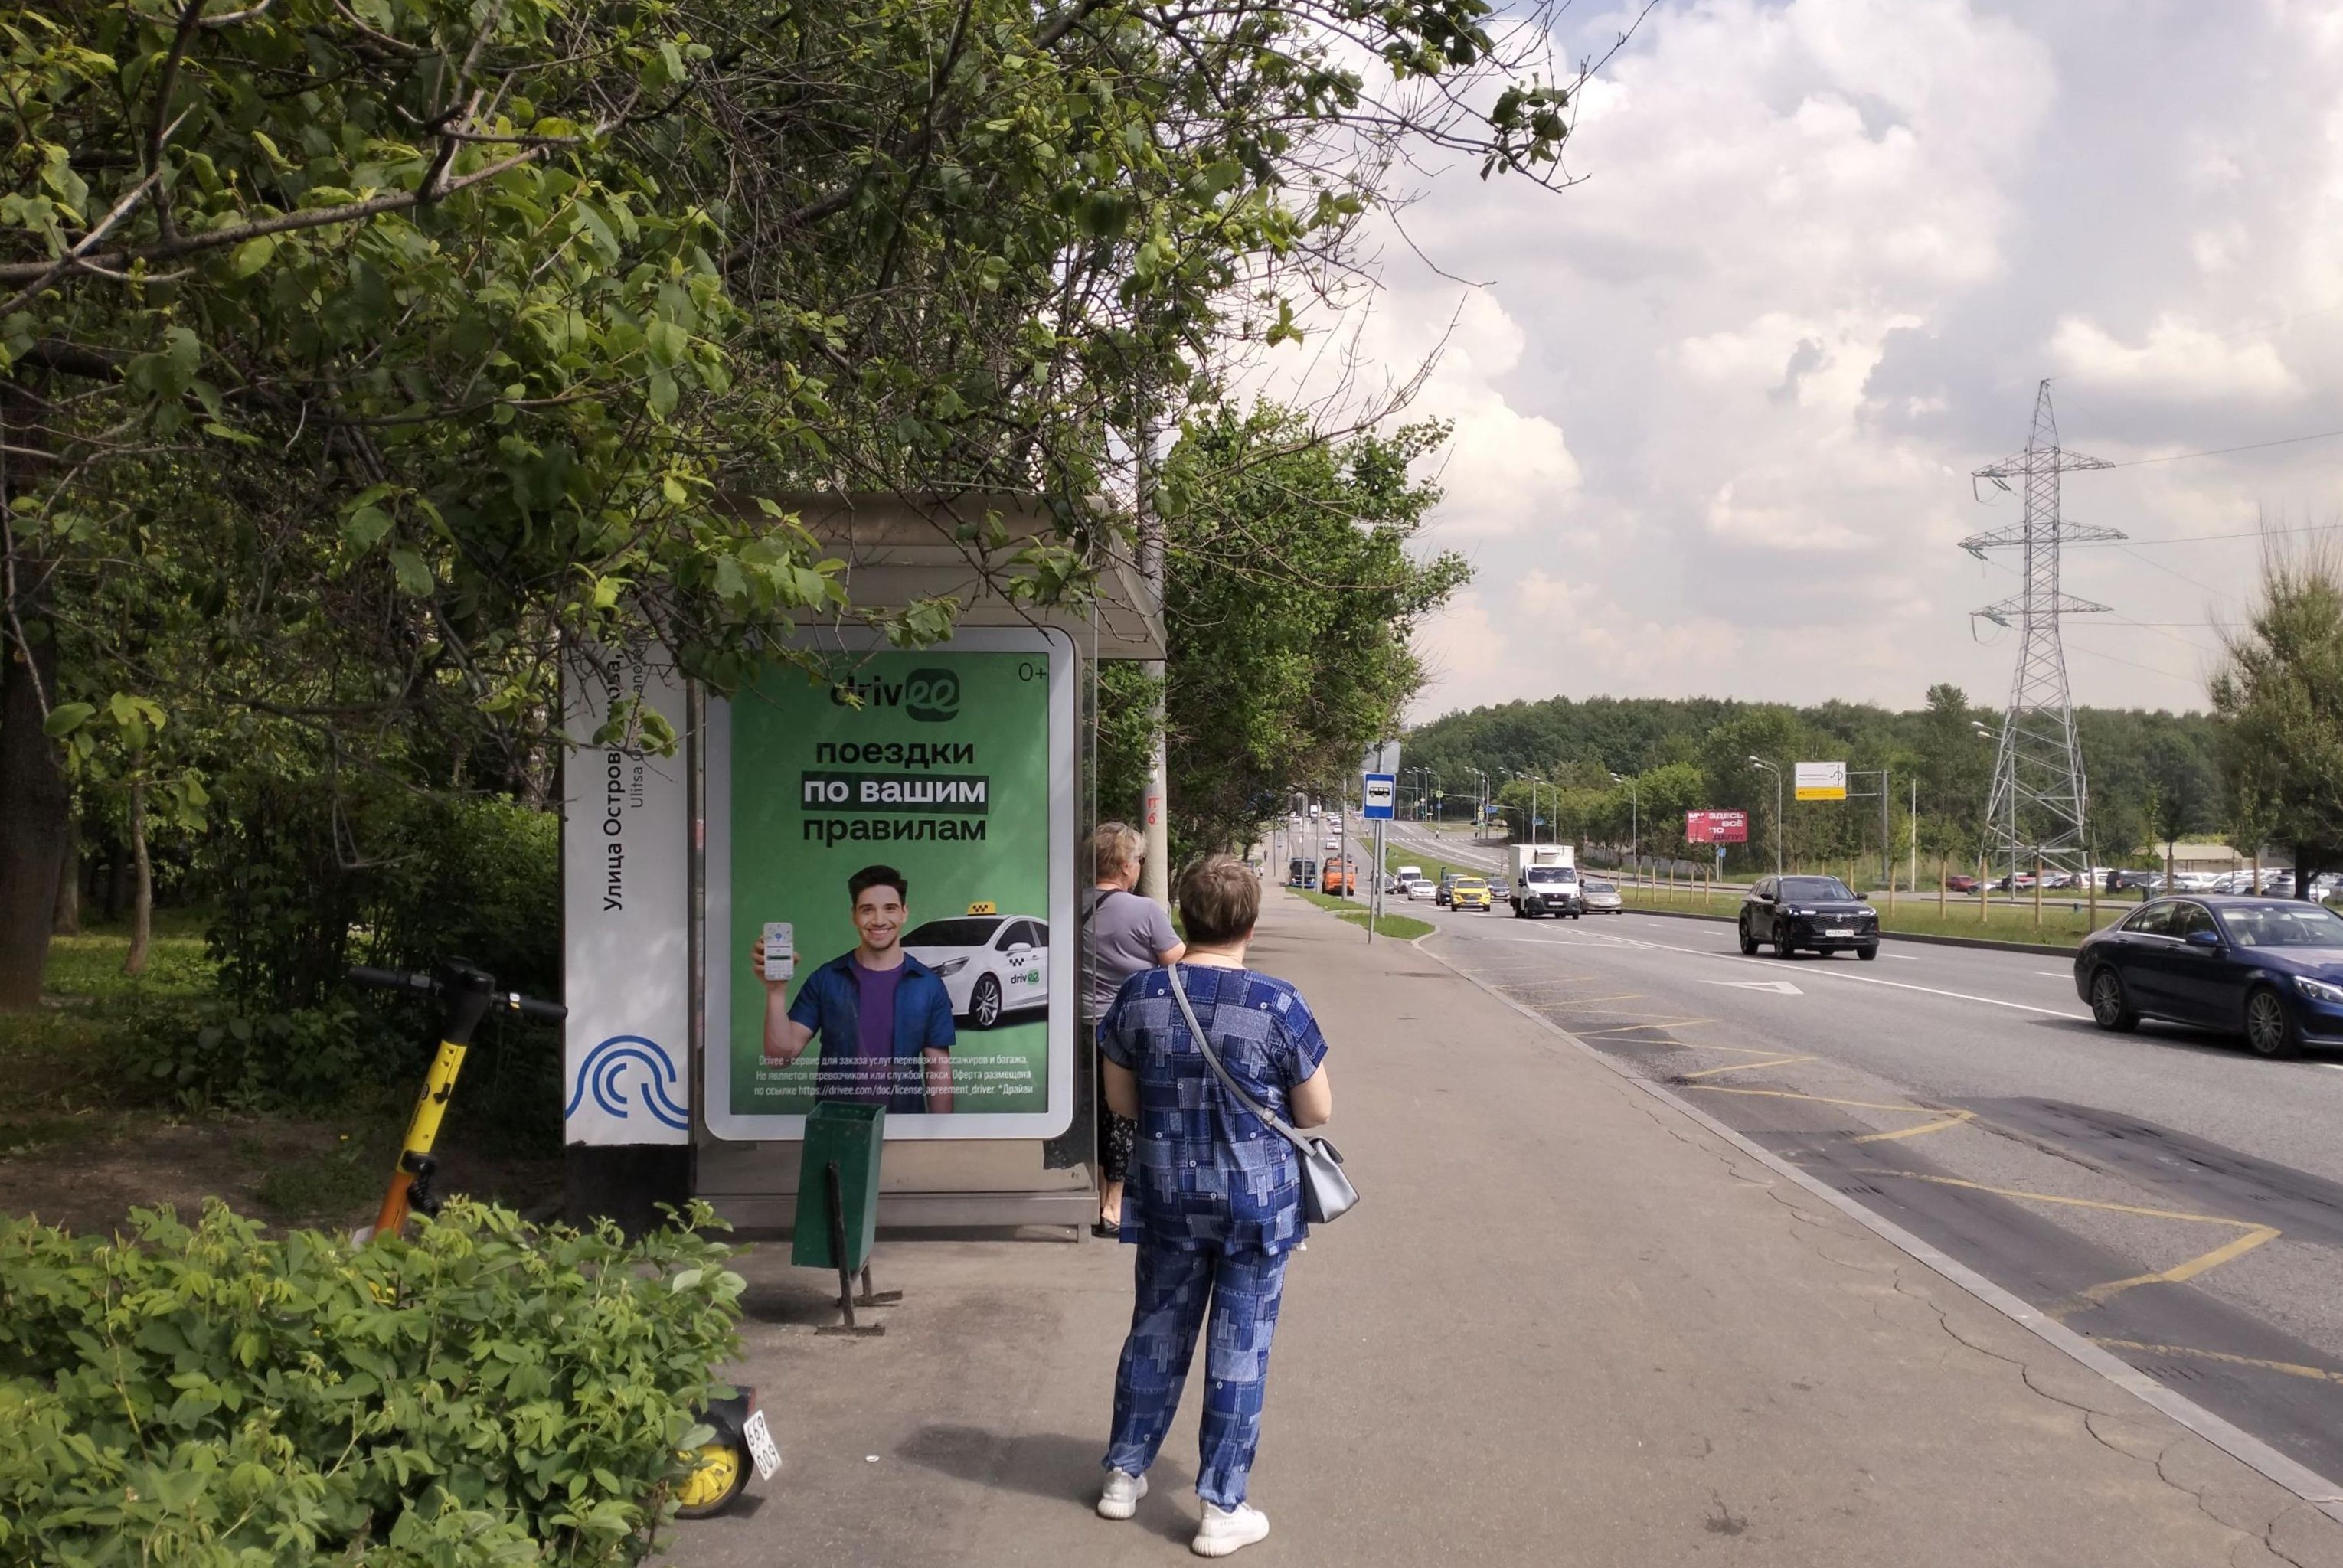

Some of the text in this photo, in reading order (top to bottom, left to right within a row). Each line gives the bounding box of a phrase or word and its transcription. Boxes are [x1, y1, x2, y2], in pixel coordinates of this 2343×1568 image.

[1018, 662, 1047, 681] 0+
[830, 674, 959, 712] drivee
[816, 742, 974, 769] поездки
[630, 766, 643, 808] Ulitsa
[804, 780, 985, 804] по вашим
[803, 818, 986, 848] правилам
[603, 842, 624, 912] Улица
[1010, 971, 1040, 984] drivee
[791, 1057, 820, 1067] сервис
[822, 1057, 838, 1066] для
[869, 1057, 891, 1067] услуг
[894, 1057, 936, 1067] перевозки
[938, 1057, 989, 1067] пассажиров
[996, 1055, 1029, 1065] багажа.
[756, 1071, 766, 1080] Не
[768, 1072, 808, 1080] является
[809, 1072, 868, 1081] перевозчиком
[887, 1070, 924, 1081] службой
[952, 1070, 982, 1080] Оферта
[984, 1070, 1031, 1080] размещена
